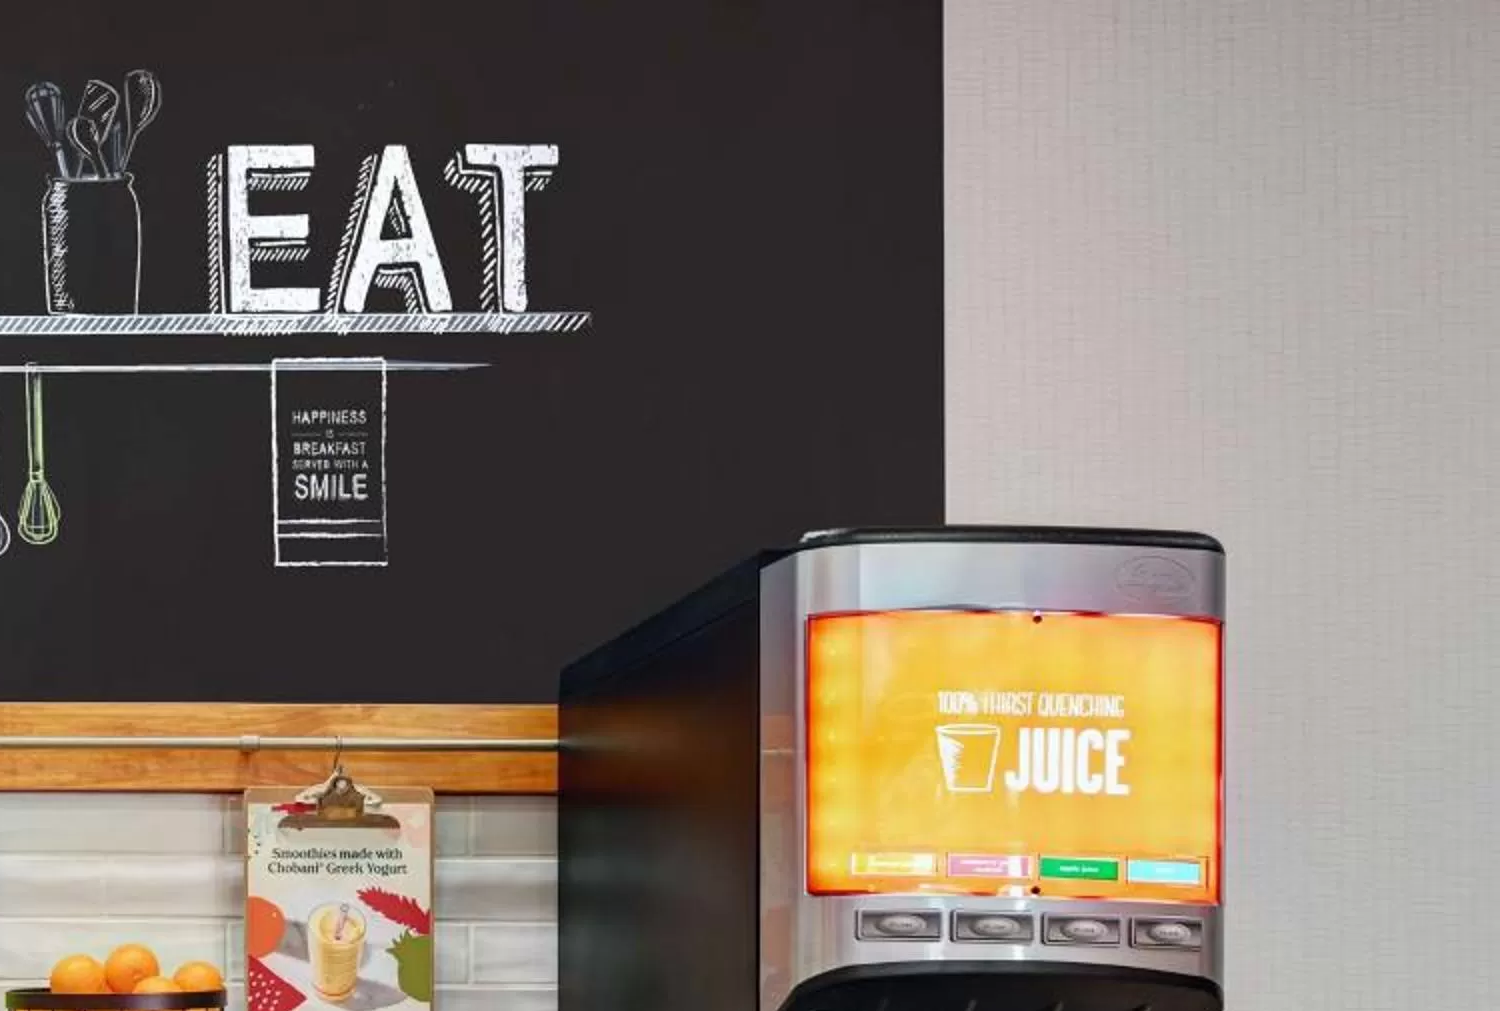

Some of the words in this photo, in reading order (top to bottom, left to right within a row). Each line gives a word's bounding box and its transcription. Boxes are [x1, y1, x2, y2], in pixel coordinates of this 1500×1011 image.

[210, 143, 559, 312] EAT
[291, 409, 367, 425] HAPPINESS
[325, 429, 334, 439] IS
[293, 441, 367, 456] BREAKFAST
[291, 459, 331, 470] SERVED
[334, 459, 359, 470] WITH
[361, 459, 369, 470] A
[295, 473, 369, 501] SMILE
[938, 690, 978, 714] 100%
[982, 690, 1034, 716] THIRST
[1038, 692, 1125, 718] QUENCHING
[1004, 726, 1132, 795] JUICE
[272, 847, 337, 859] Smoothies
[339, 847, 373, 859] made
[375, 847, 403, 859] with
[326, 862, 364, 874] Greek
[367, 863, 408, 876] Yogurt
